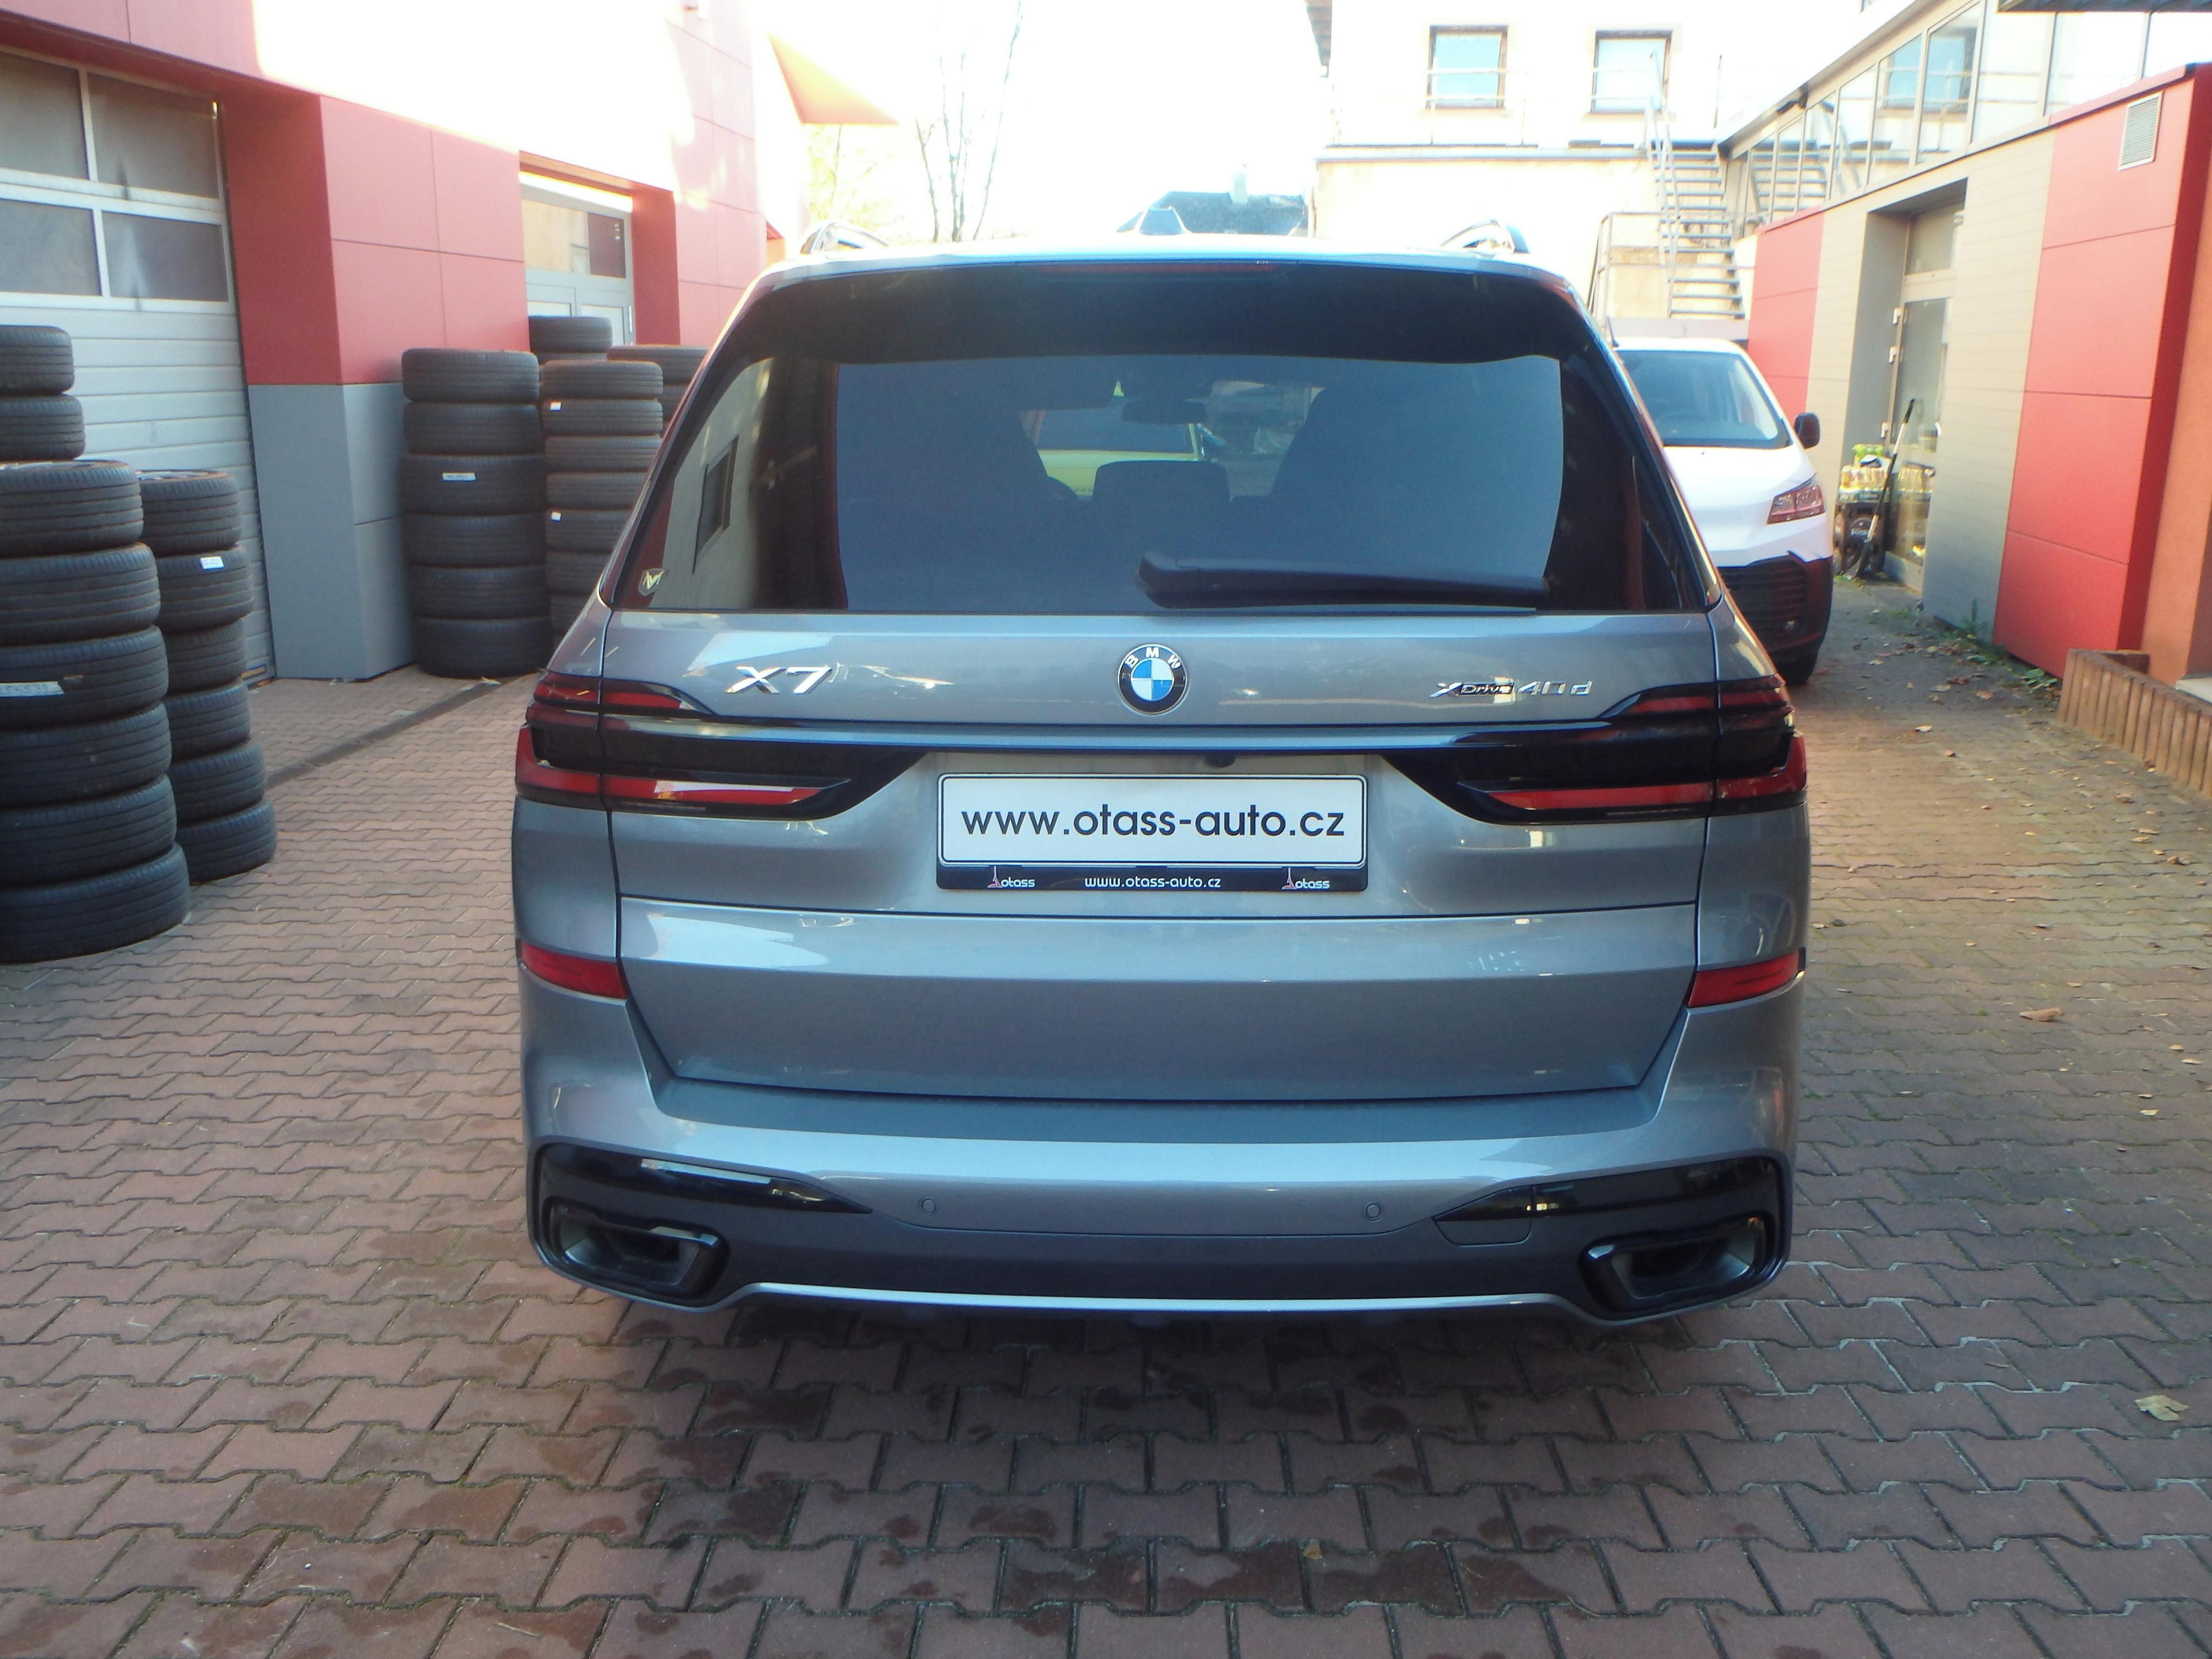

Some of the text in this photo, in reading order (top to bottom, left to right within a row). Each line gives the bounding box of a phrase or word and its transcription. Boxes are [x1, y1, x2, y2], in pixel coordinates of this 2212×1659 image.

[1124, 647, 1182, 669] BMW
[725, 666, 833, 694] X7
[961, 804, 1345, 836] www.otass-auto.cz
[1000, 876, 1035, 888] otass
[1084, 876, 1221, 888] www.otass-auto.cz
[1294, 878, 1330, 889] otass
